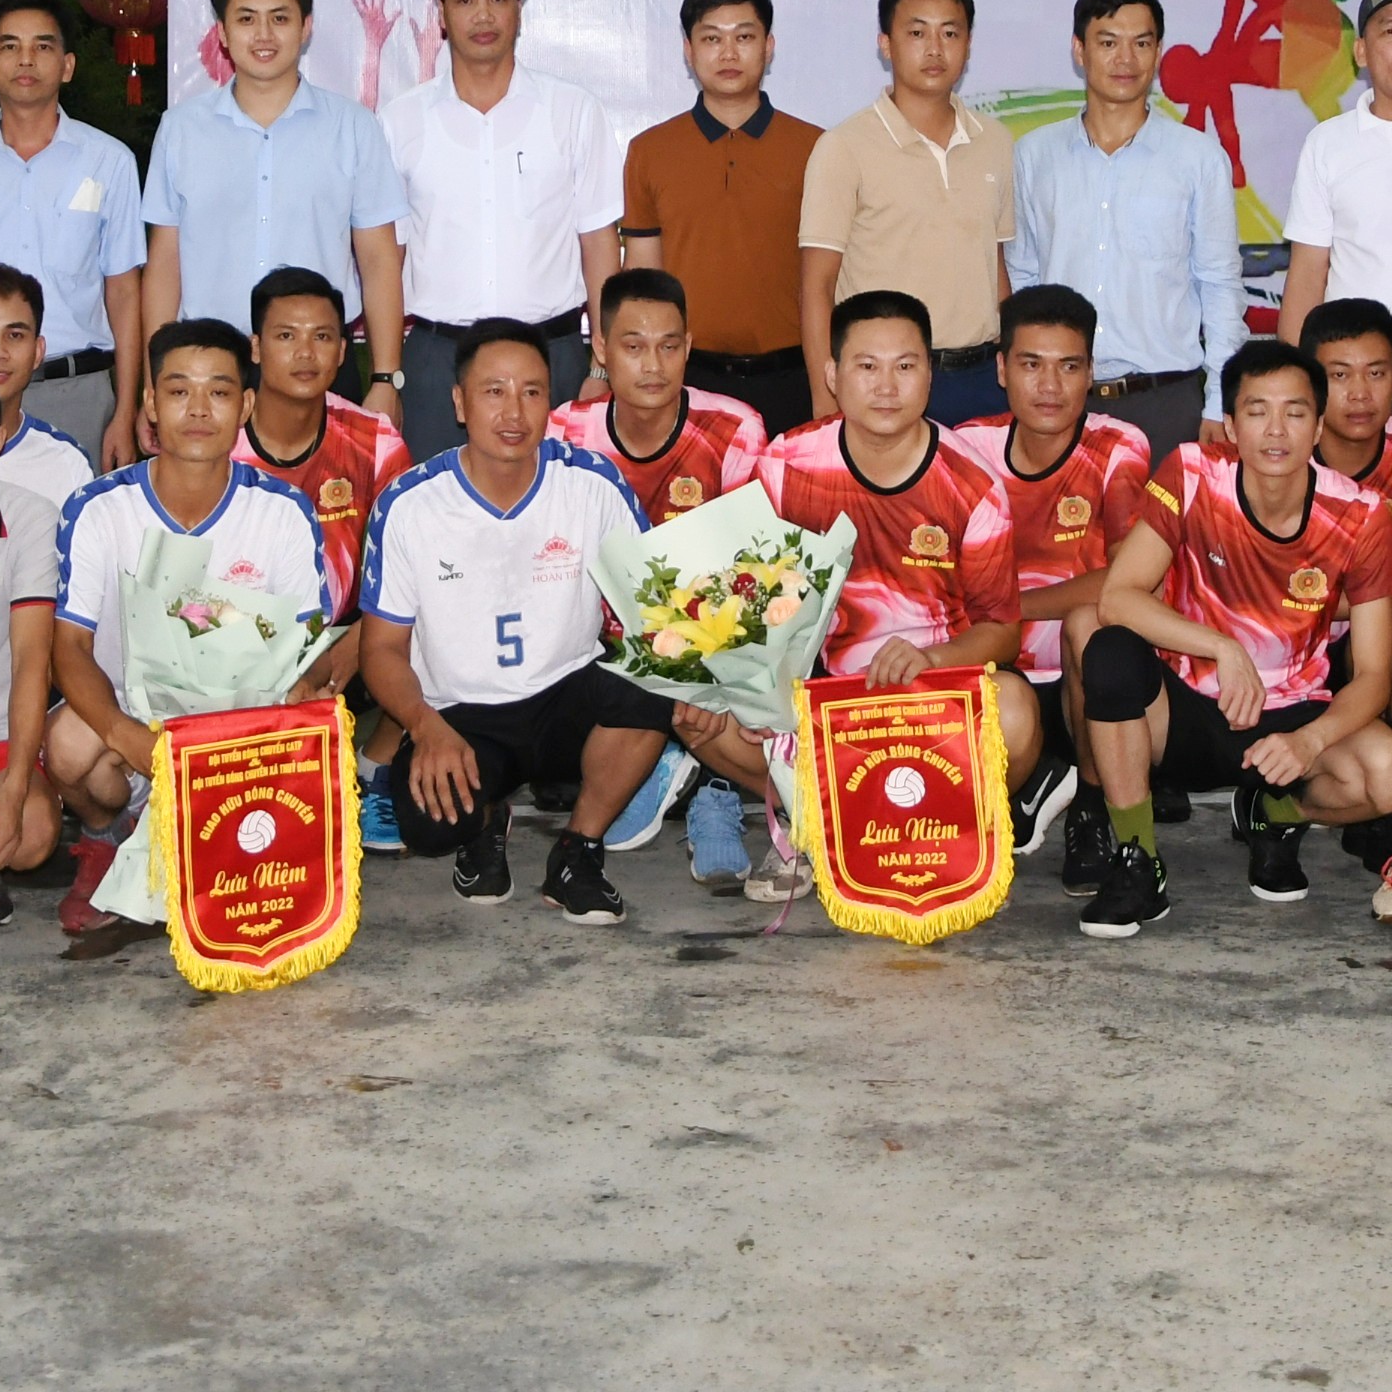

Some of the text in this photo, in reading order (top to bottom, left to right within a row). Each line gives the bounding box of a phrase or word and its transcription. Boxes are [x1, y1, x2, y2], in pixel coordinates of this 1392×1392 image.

[495, 612, 524, 668] 5
[846, 765, 867, 792] GIAO
[889, 742, 921, 758] BÓNG
[199, 812, 221, 840] GIAO
[244, 785, 274, 803] BÓNG
[860, 817, 960, 847] Lưu Niệm
[878, 852, 947, 867] NĂM 2022
[209, 861, 307, 898] Lưu Niệm
[225, 896, 294, 920] NĂM 2022
